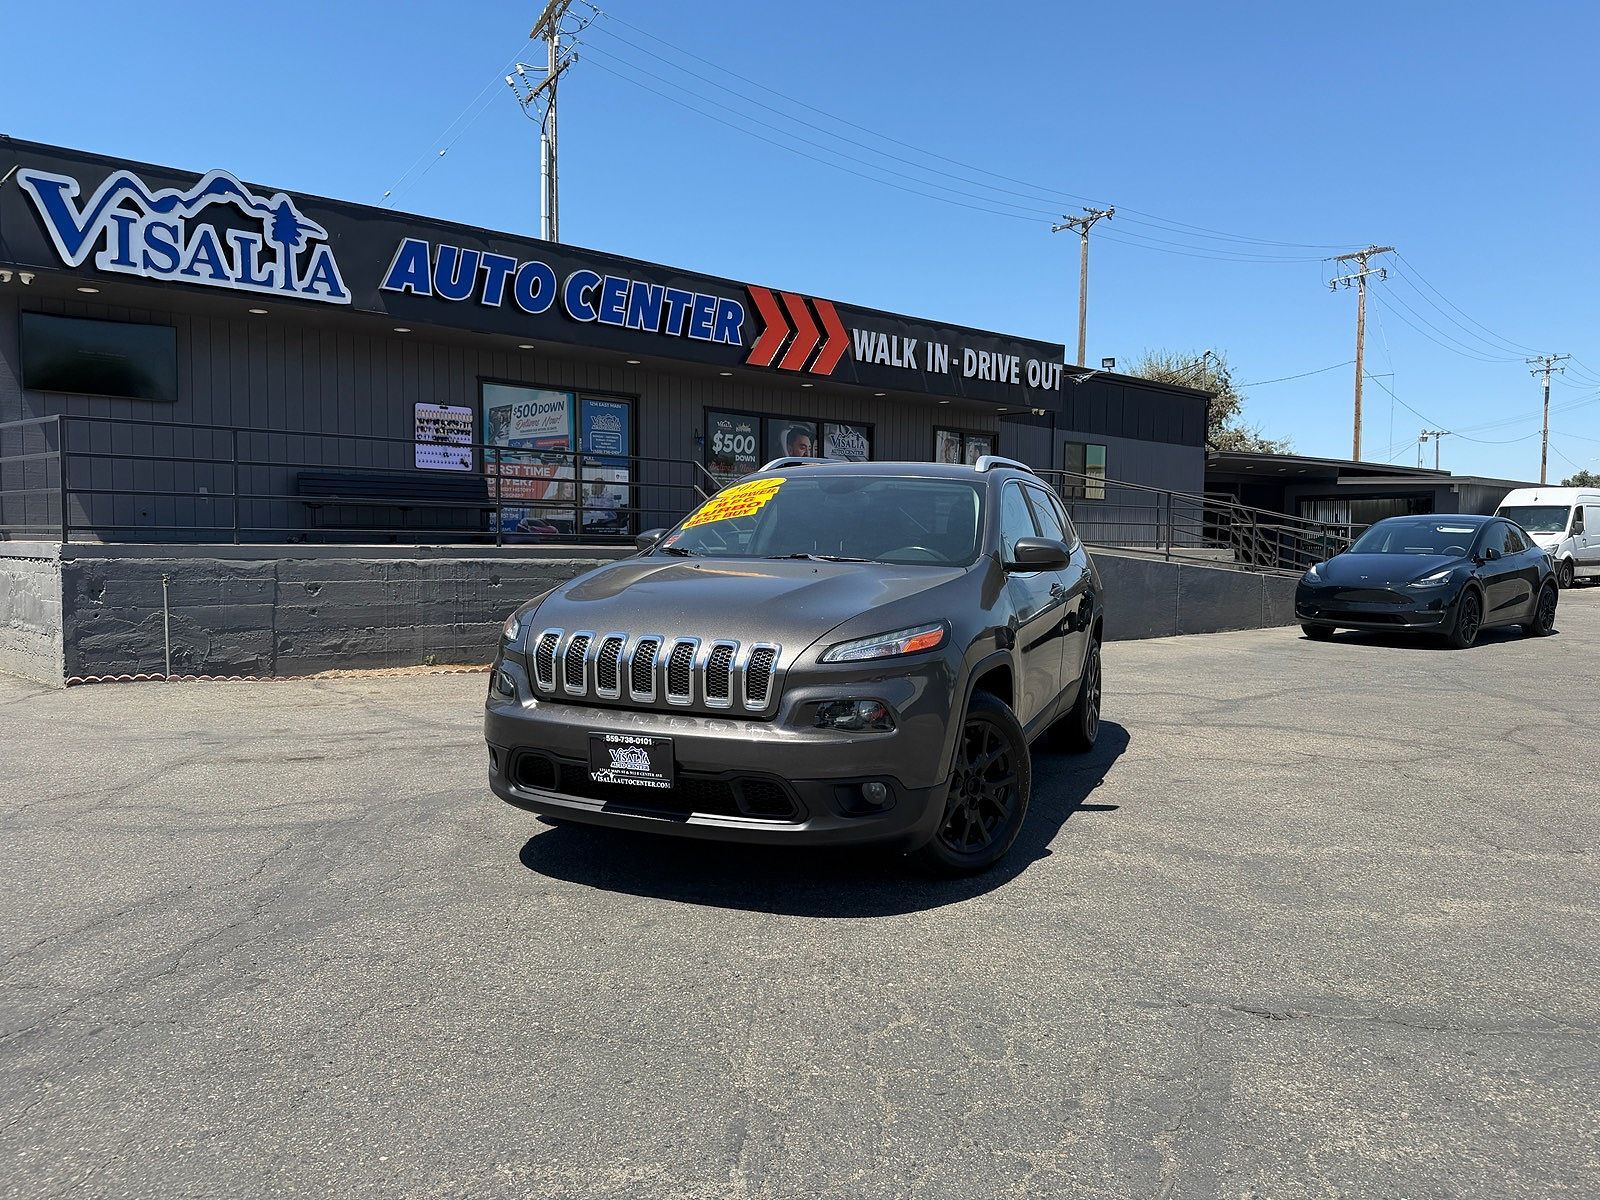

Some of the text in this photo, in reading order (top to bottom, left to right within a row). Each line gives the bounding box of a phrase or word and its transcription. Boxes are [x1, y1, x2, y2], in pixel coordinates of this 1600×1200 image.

[17, 168, 352, 305] VISALIA
[379, 237, 745, 346] AUTO CENTER
[852, 328, 918, 370] WALK
[926, 341, 949, 374] IN
[963, 347, 1020, 385] DRIVE
[1026, 358, 1063, 391] OUT
[513, 401, 565, 419] $500 DOWN
[712, 430, 756, 455] $500
[830, 428, 865, 449] VISALIA
[735, 454, 756, 463] DOWN
[487, 464, 551, 477] FRST TIME
[732, 487, 778, 500] POWER
[686, 508, 753, 527] BEST BUY
[693, 501, 762, 519] TURBO
[606, 735, 652, 745] 559-738-0101
[609, 746, 650, 764] VISALIA
[627, 763, 651, 772] CENTER
[591, 771, 671, 788] VISALIAAUTOCENTER.COM
